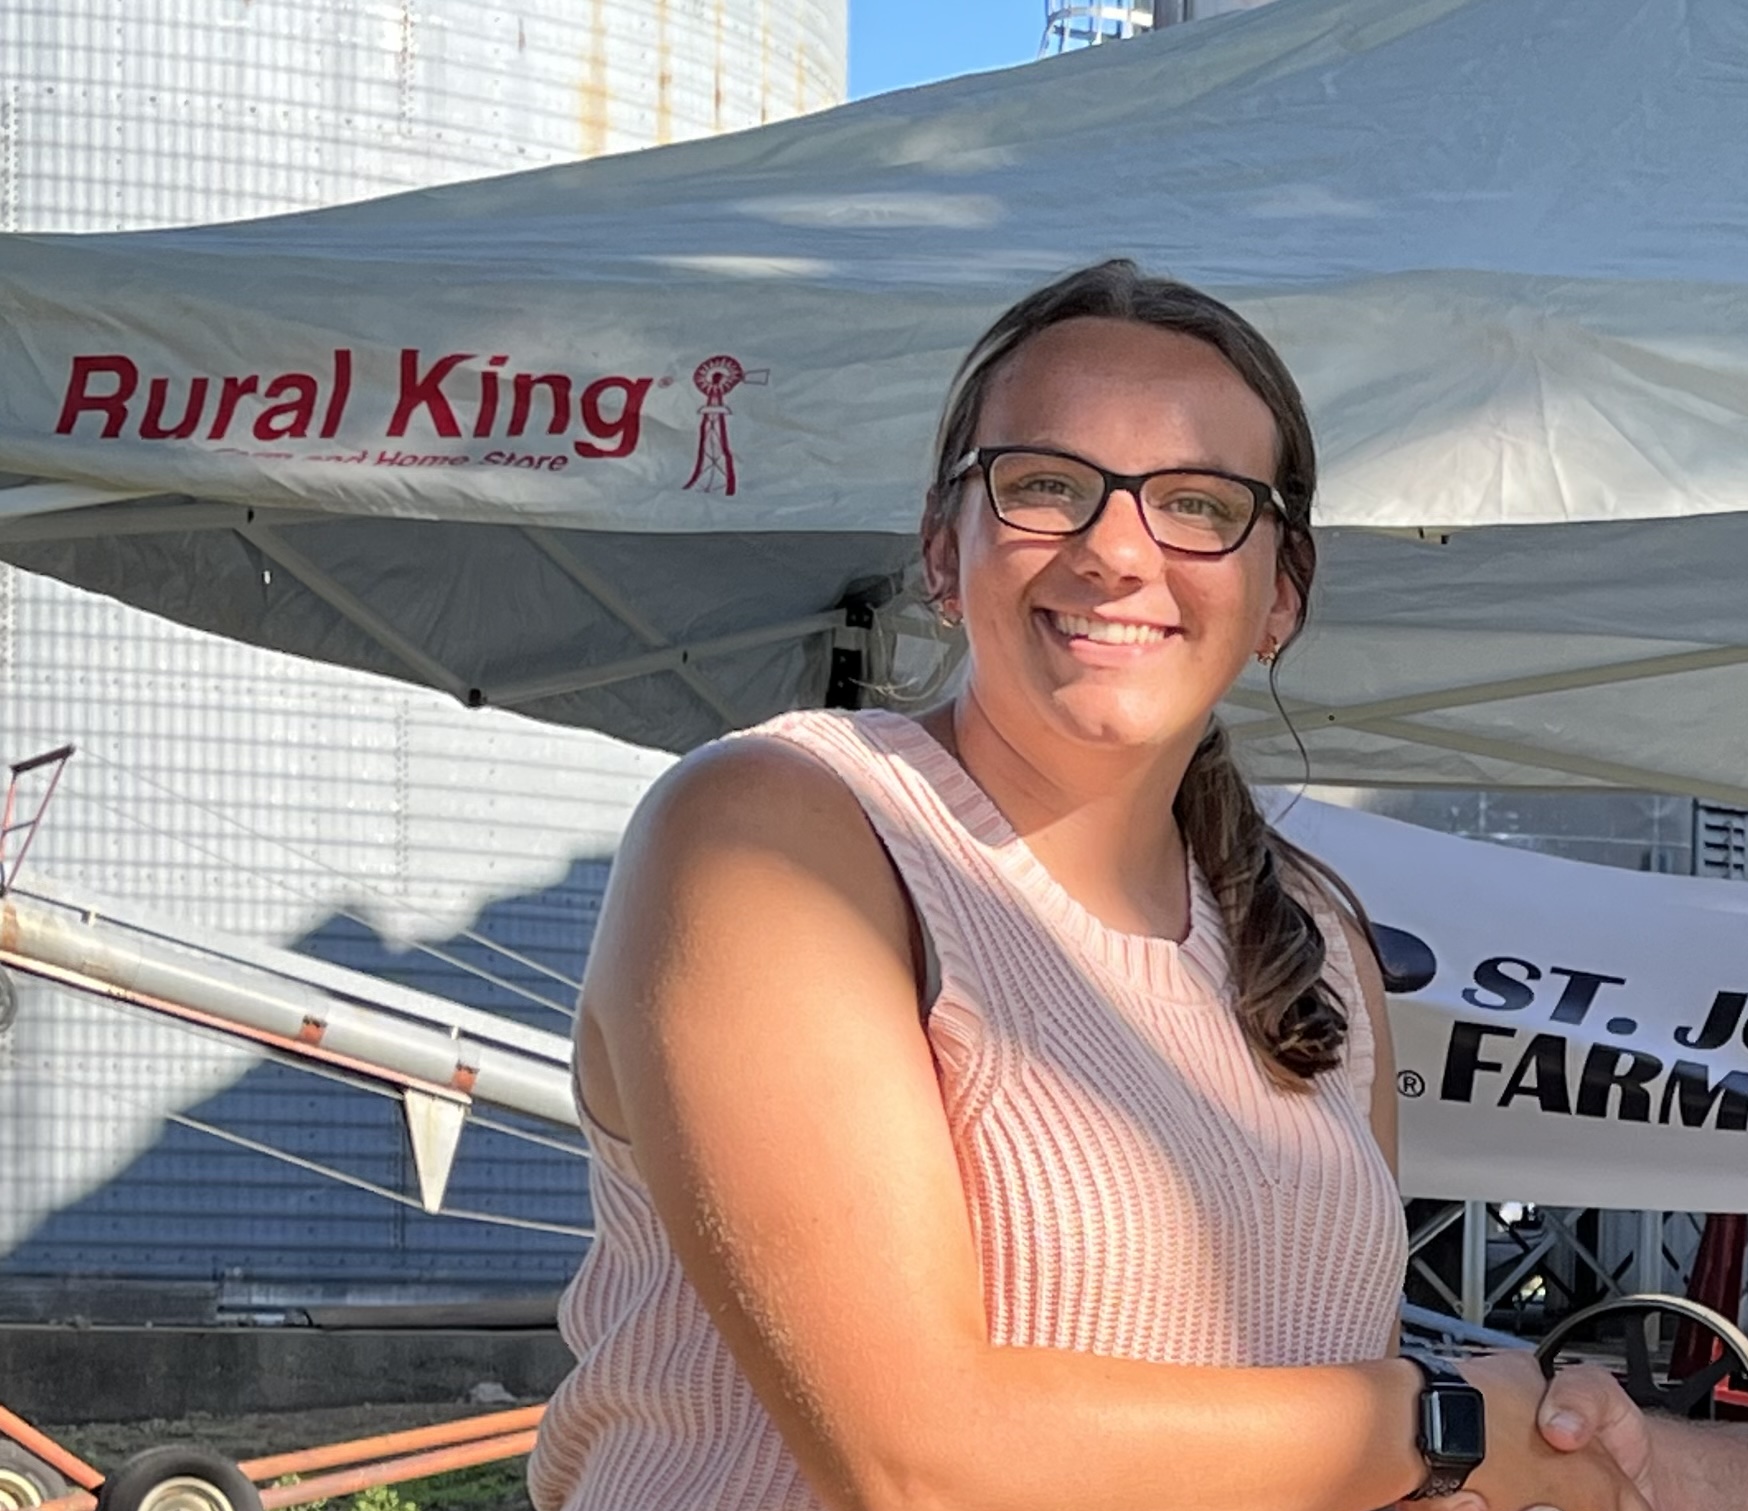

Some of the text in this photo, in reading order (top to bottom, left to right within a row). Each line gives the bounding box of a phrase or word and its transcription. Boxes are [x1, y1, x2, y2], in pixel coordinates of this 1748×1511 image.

[56, 348, 652, 459] Rural King
[477, 451, 570, 472] Store
[1461, 956, 1637, 1036] ST.
